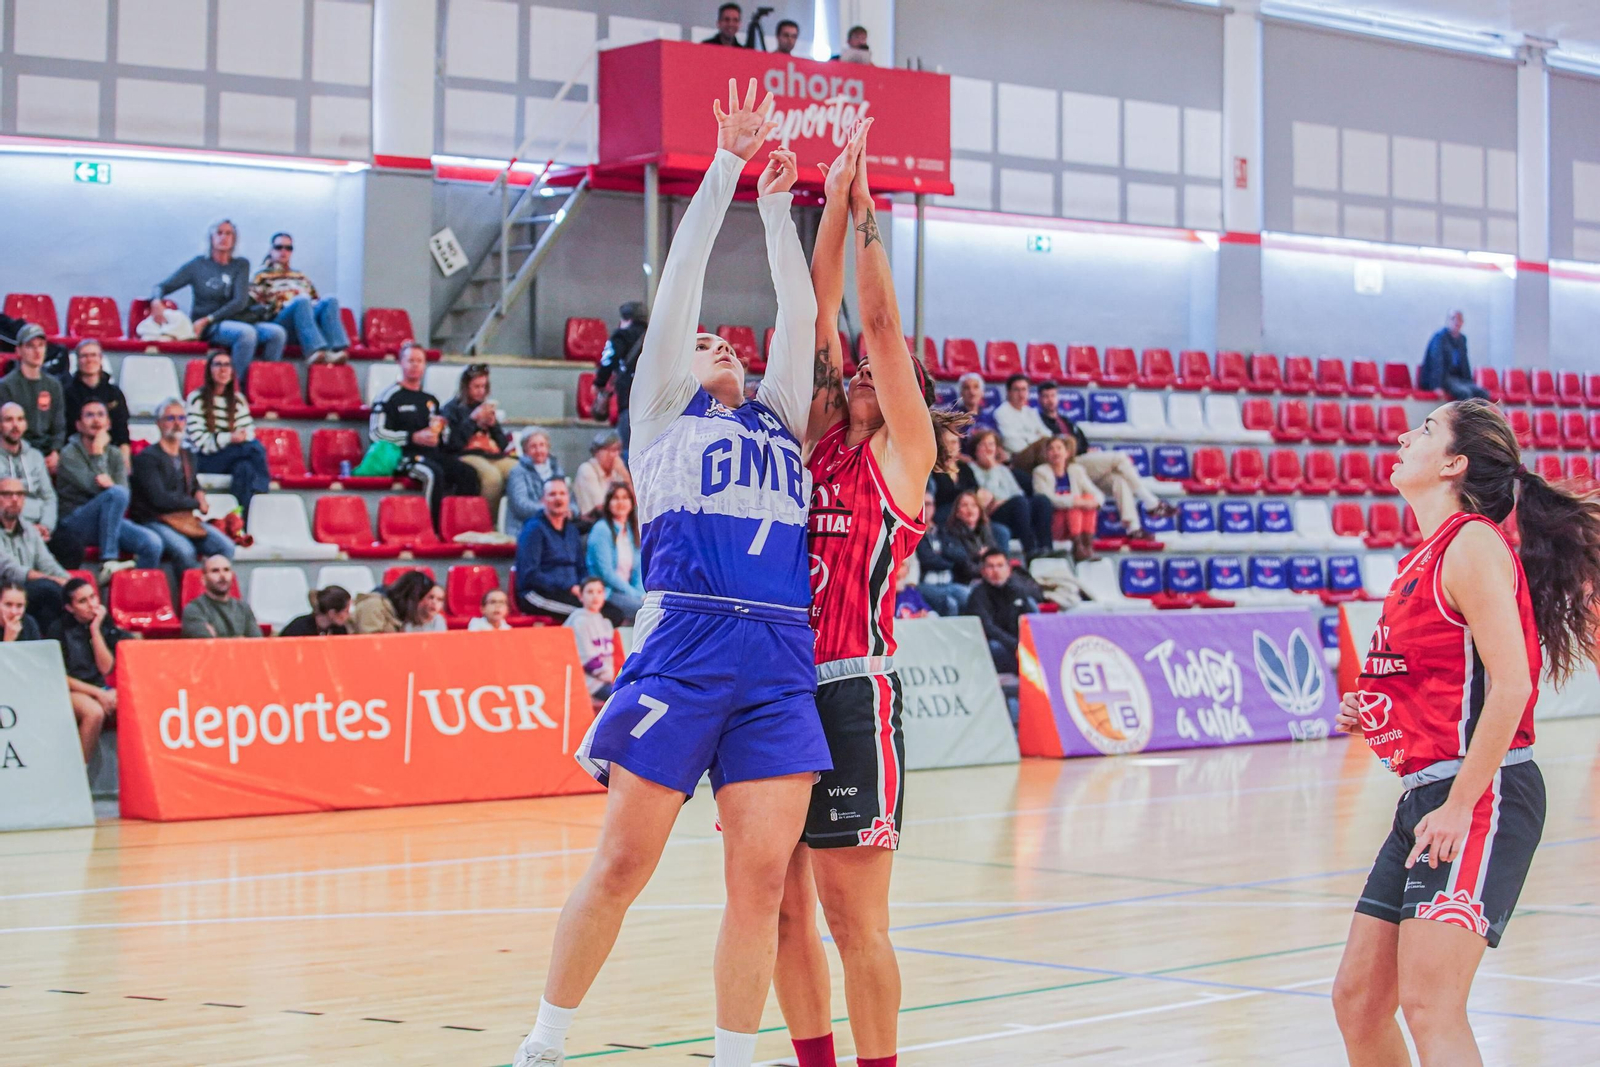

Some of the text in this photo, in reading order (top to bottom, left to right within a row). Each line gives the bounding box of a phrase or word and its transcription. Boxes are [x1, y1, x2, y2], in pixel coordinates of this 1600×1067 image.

[764, 62, 864, 104] ahora
[701, 433, 805, 509] GMB
[747, 508, 773, 555] 7
[1371, 658, 1408, 675] TIAS
[159, 684, 559, 764] deportes UGR
[630, 693, 669, 739] 7
[827, 785, 858, 797] vive
